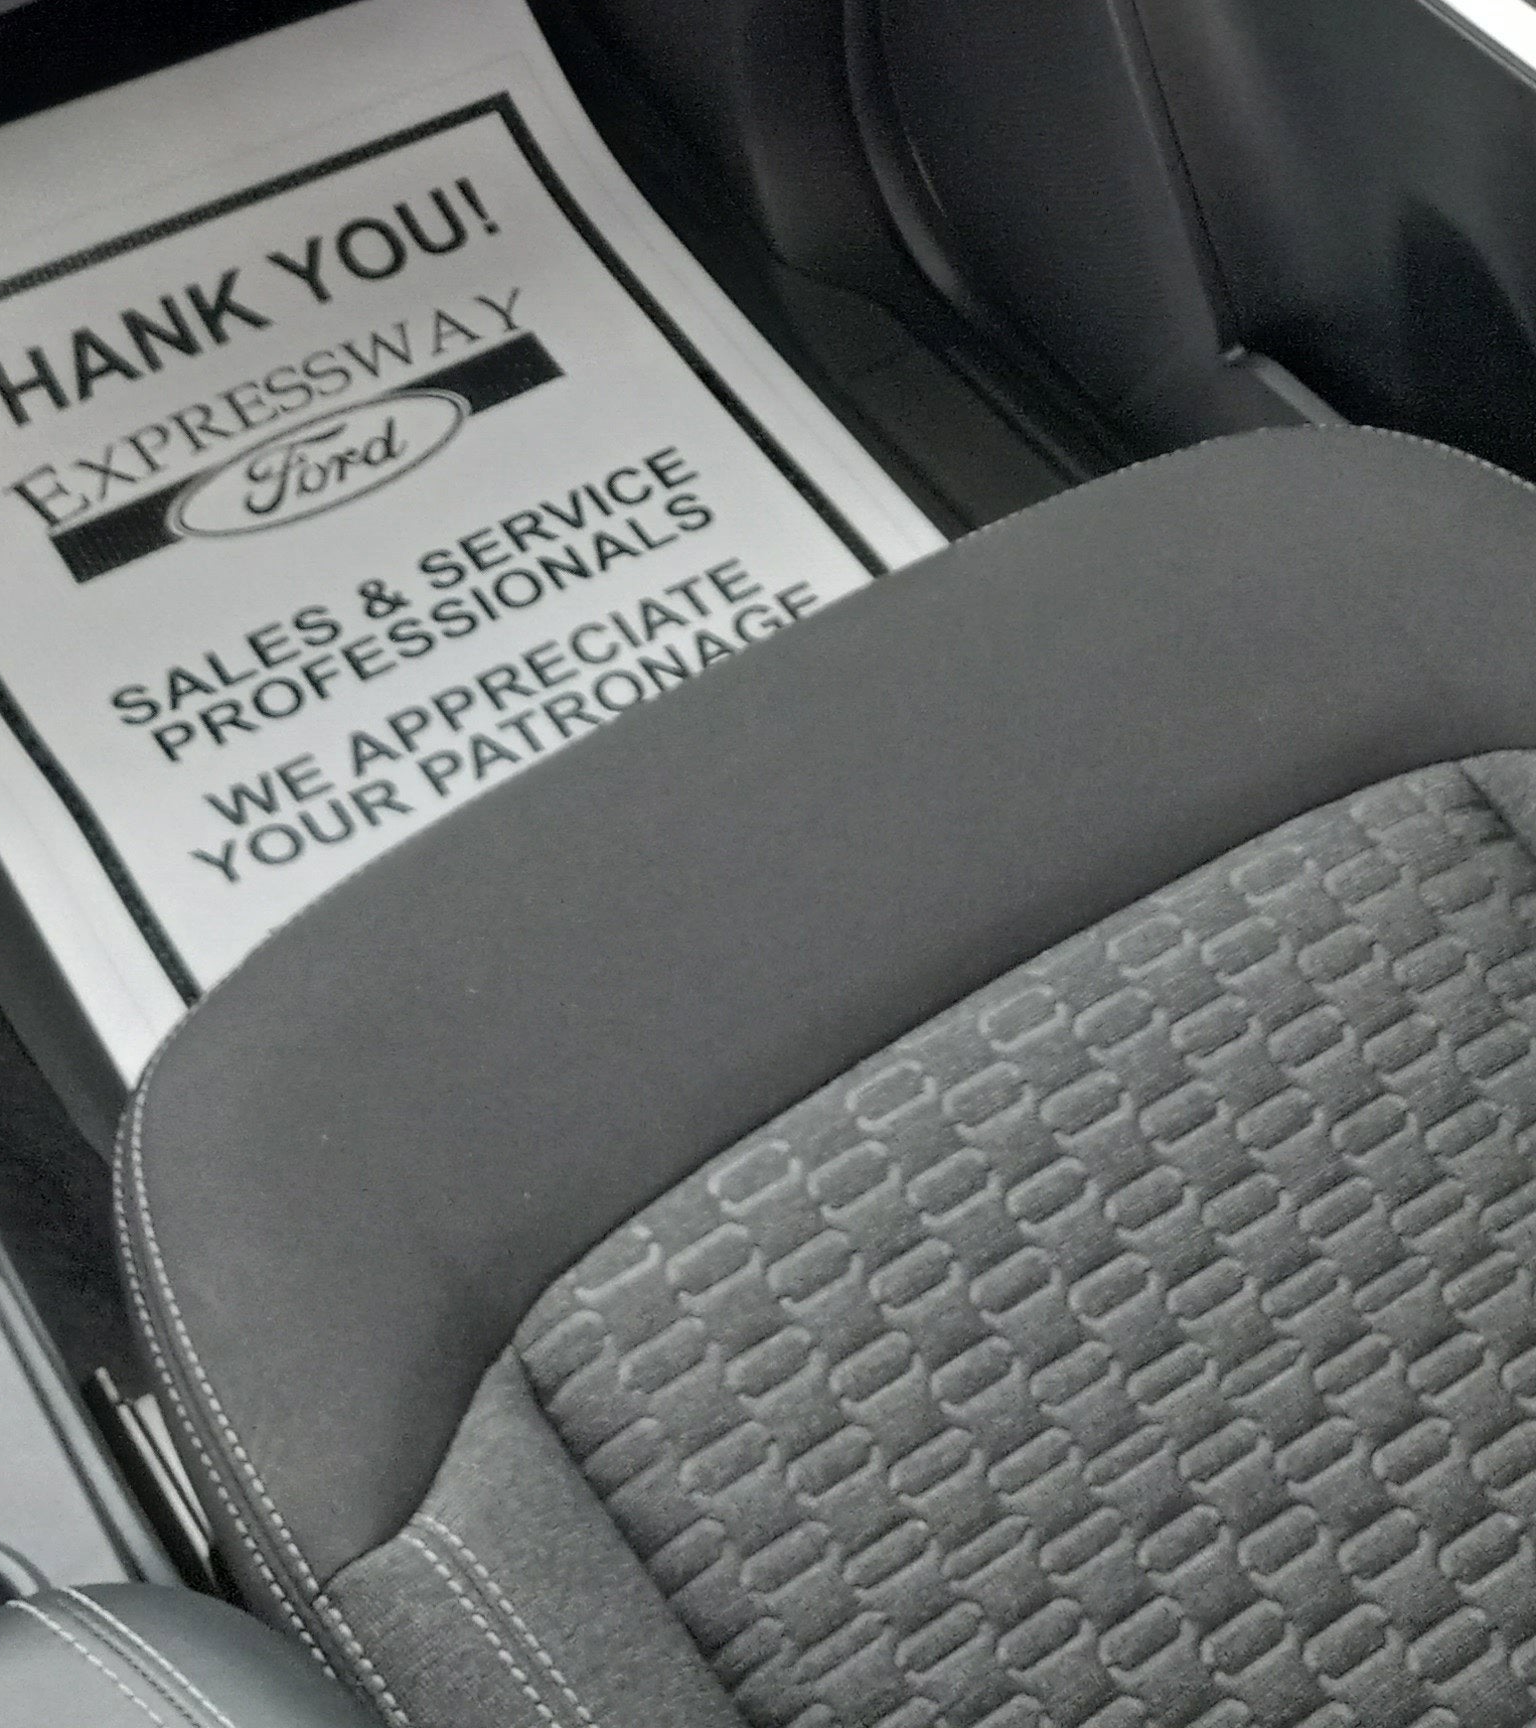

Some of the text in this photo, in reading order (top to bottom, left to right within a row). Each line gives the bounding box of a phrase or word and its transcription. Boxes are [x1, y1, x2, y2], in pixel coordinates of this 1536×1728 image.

[266, 178, 502, 306] YOU!
[3, 287, 531, 532] EXPRESSWAY
[243, 421, 410, 520] Ford
[109, 445, 700, 728] SALES & SERVICE
[151, 494, 716, 763] PROFESSIONALS
[203, 558, 765, 828] WE APPRECIATE
[189, 581, 819, 884] YOUR PATRONAGE
